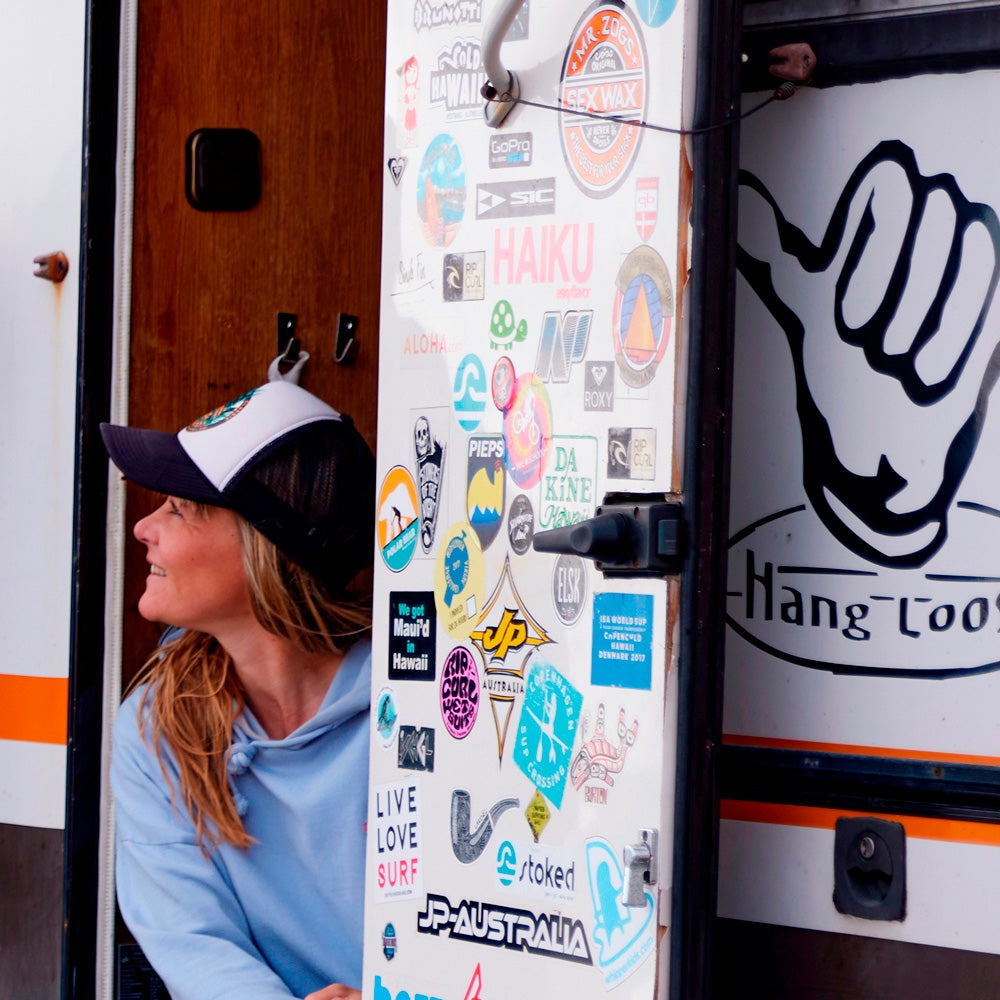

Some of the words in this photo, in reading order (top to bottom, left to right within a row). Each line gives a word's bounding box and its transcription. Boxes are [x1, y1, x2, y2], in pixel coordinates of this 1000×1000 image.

[602, 15, 633, 56] ZOGS
[567, 87, 599, 113] SEX
[600, 81, 638, 109] WAX
[492, 140, 530, 153] GoPro
[493, 223, 595, 284] HAIKU
[466, 275, 482, 288] CURL
[404, 333, 447, 355] ALOHA
[584, 391, 613, 408] ROXY
[469, 440, 503, 457] PIEPS
[633, 439, 646, 449] RIP
[555, 447, 578, 472] DA
[633, 453, 653, 467] CURL
[558, 567, 581, 604] ELSK
[746, 549, 871, 641] Hang
[899, 597, 1000, 638] Loo
[398, 603, 410, 616] We
[411, 604, 424, 619] got
[612, 615, 633, 625] WORLD
[394, 618, 430, 637] Maui'd
[482, 607, 528, 661] JP
[407, 640, 415, 653] in
[598, 651, 629, 661] DENMARK
[631, 654, 645, 662] 2017
[611, 642, 634, 651] HAWAII
[393, 653, 428, 671] Hawaii
[444, 651, 468, 678] RIP
[442, 676, 478, 705] CURL
[483, 680, 525, 693] AUSTRALIA
[526, 762, 565, 789] CROSSING
[376, 786, 417, 818] LIVE
[377, 822, 418, 854] LOVE
[377, 858, 418, 889] SURF
[519, 854, 575, 891] stoked
[418, 899, 590, 959] JP-AUSTRALIA
